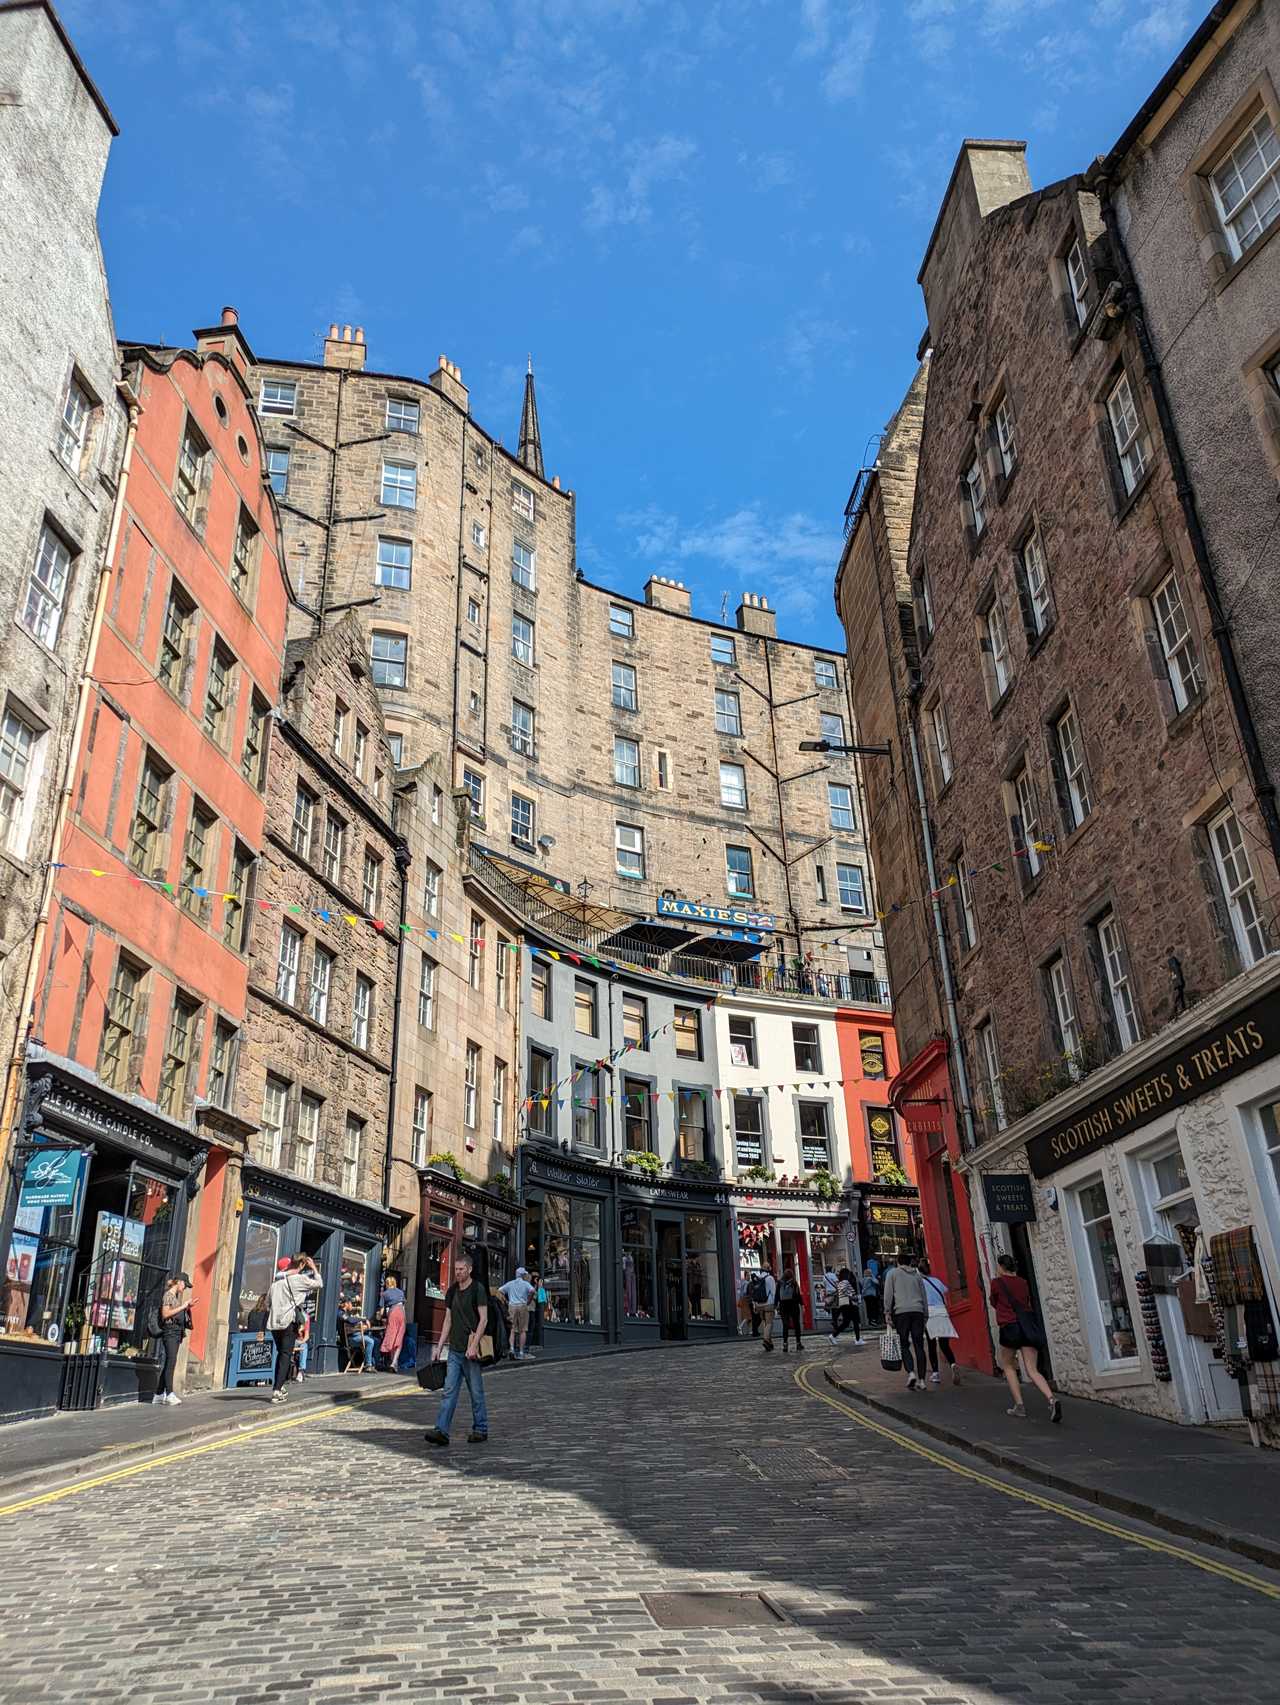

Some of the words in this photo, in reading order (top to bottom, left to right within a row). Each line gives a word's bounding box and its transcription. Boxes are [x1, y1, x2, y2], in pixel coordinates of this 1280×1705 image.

[1050, 1108, 1113, 1159] SCOTTISH
[1114, 1072, 1174, 1125] SWEETS
[1177, 1063, 1191, 1091] &
[1192, 1020, 1264, 1081] TREATS
[43, 1092, 62, 1106] SLE
[65, 1099, 78, 1113] OF
[80, 1106, 104, 1125] SKYE
[106, 1117, 138, 1139] CANDLE
[140, 1135, 153, 1147] CO.
[546, 1166, 572, 1183] Walker
[576, 1175, 601, 1188] Slater
[247, 1183, 260, 1197] 89
[649, 1187, 689, 1201] LADIESWEAR
[991, 1184, 1026, 1193] SCOTTISH
[996, 1193, 1024, 1201] SWEETS
[1002, 1203, 1029, 1212] TREATS
